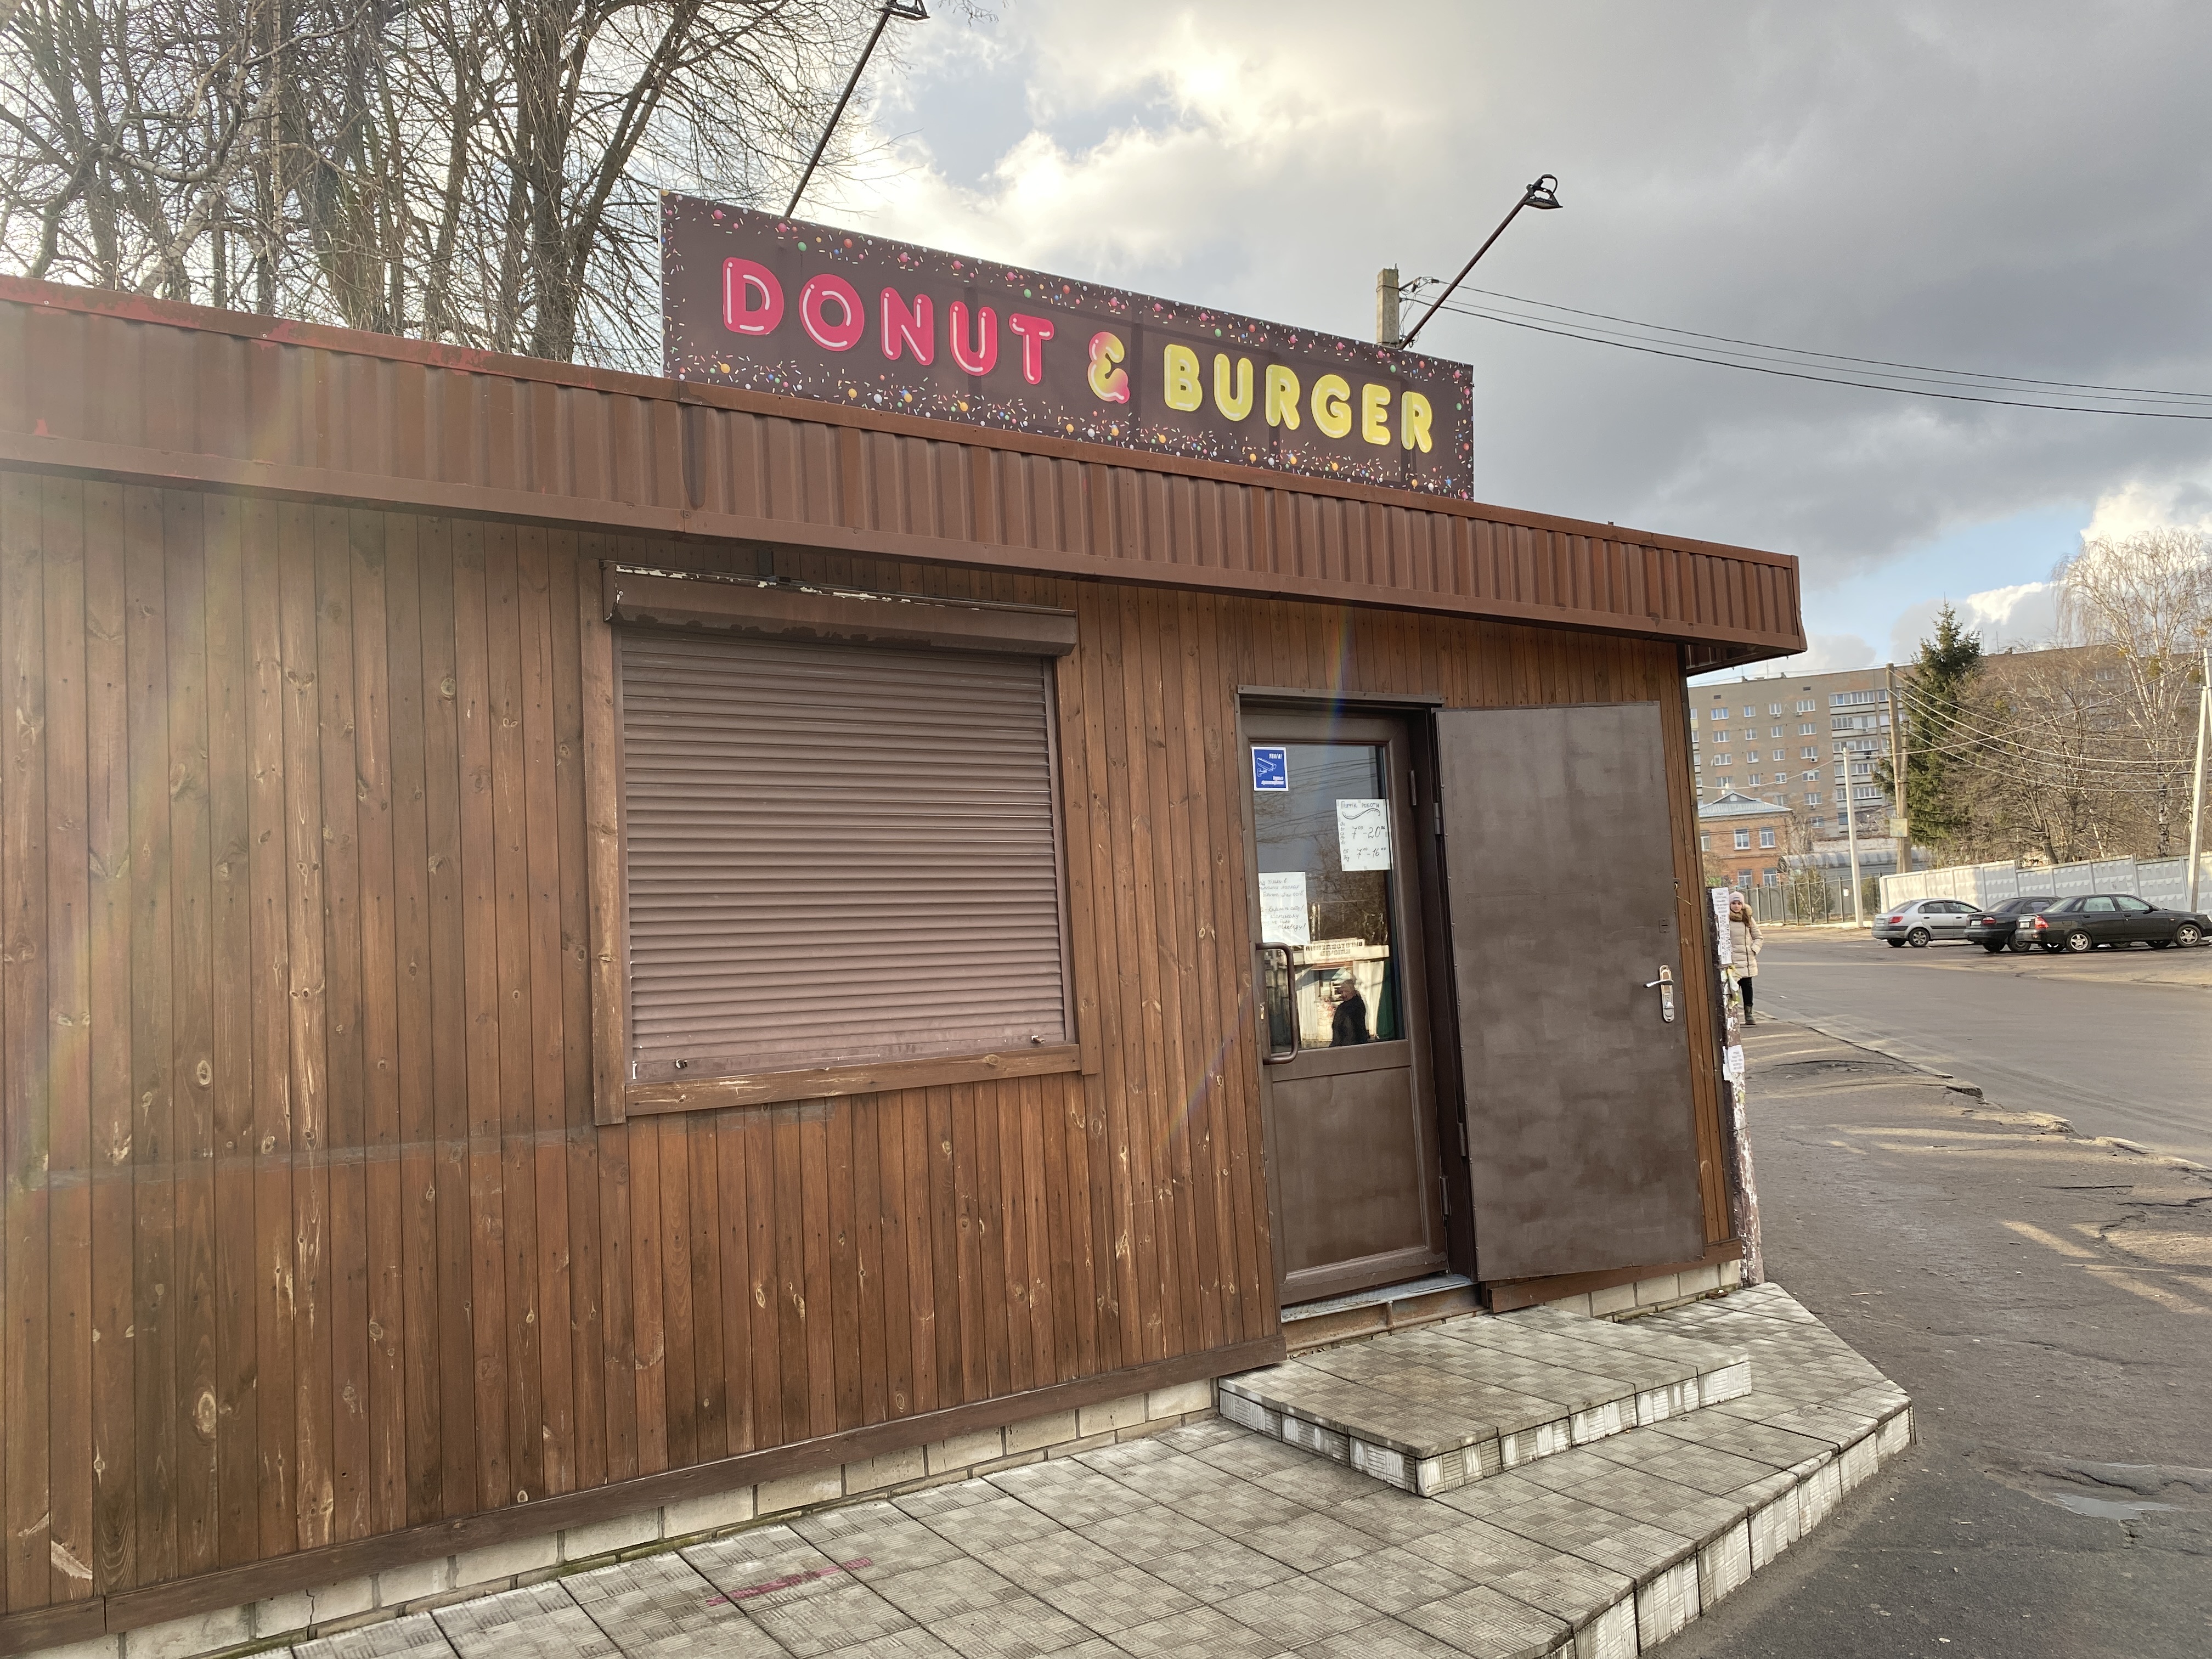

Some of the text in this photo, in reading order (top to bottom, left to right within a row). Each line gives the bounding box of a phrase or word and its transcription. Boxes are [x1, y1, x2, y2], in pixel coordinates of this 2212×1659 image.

[722, 257, 1434, 454] DONUT & BURGER
